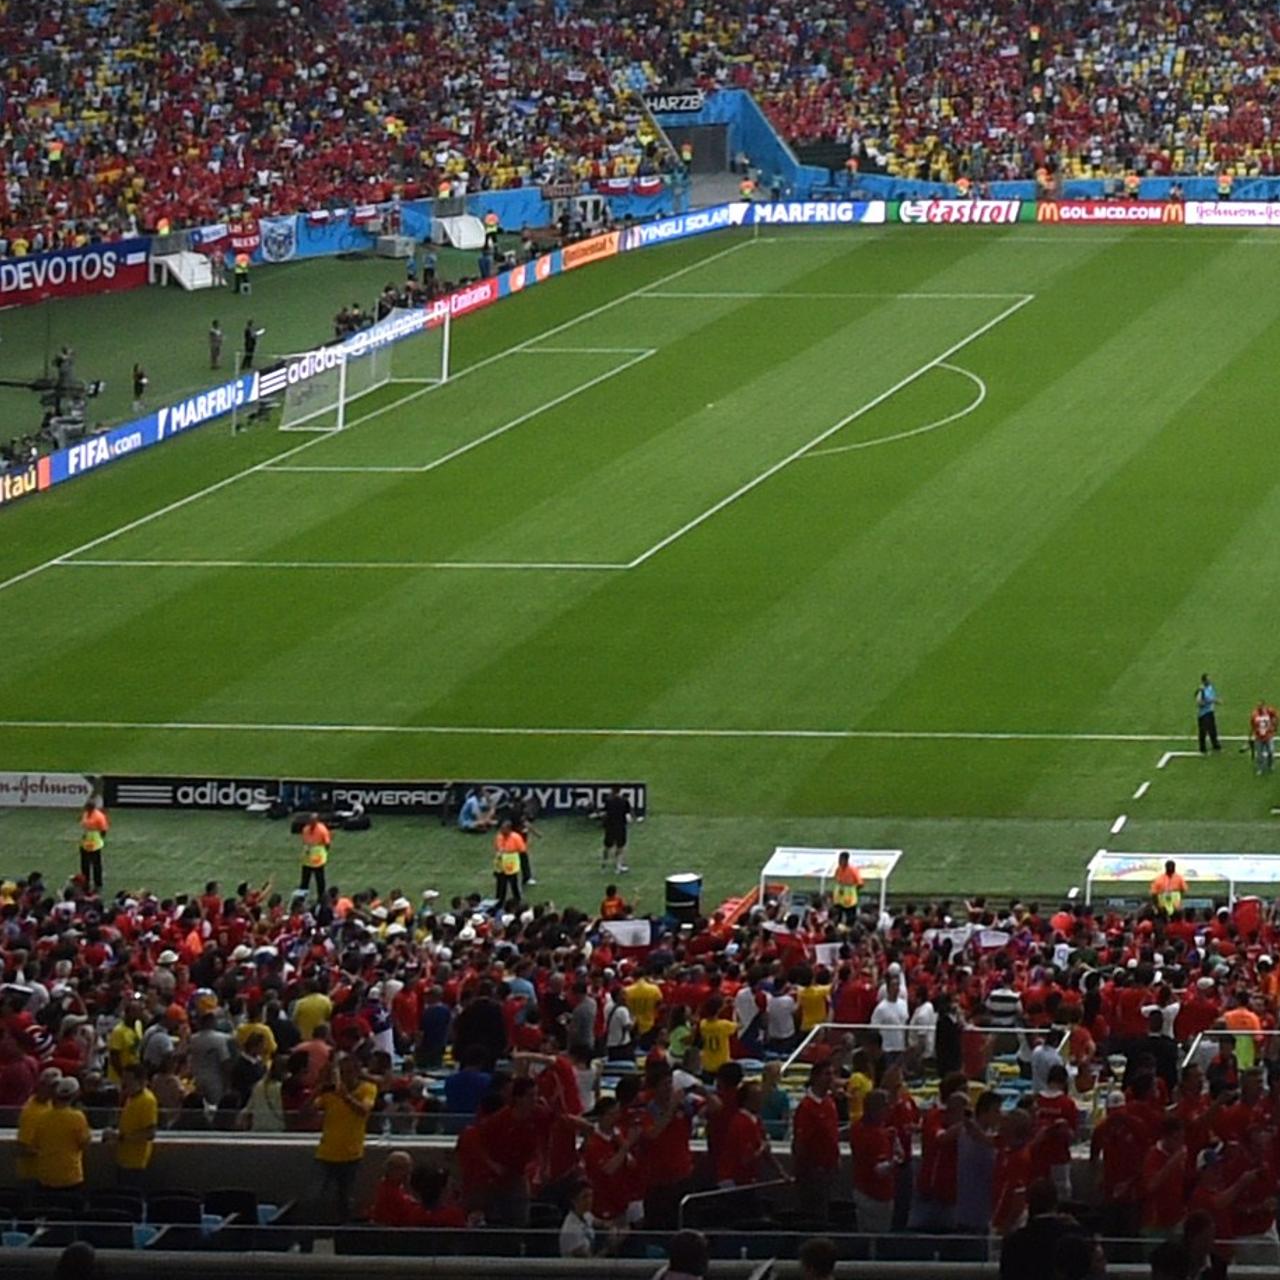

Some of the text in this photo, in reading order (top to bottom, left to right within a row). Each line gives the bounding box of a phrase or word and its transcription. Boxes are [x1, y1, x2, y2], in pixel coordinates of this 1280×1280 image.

[686, 207, 730, 233] SOLAR
[755, 201, 853, 223] MARFRIG
[926, 200, 1017, 223] Castrol
[1, 251, 117, 292] DEVOTOS
[450, 284, 491, 314] Emirates
[287, 344, 346, 384] adidas
[170, 379, 245, 432] MARFRIG
[68, 432, 142, 476] FIFA.com
[176, 781, 267, 806] adidas
[332, 788, 455, 806] POWERAD
